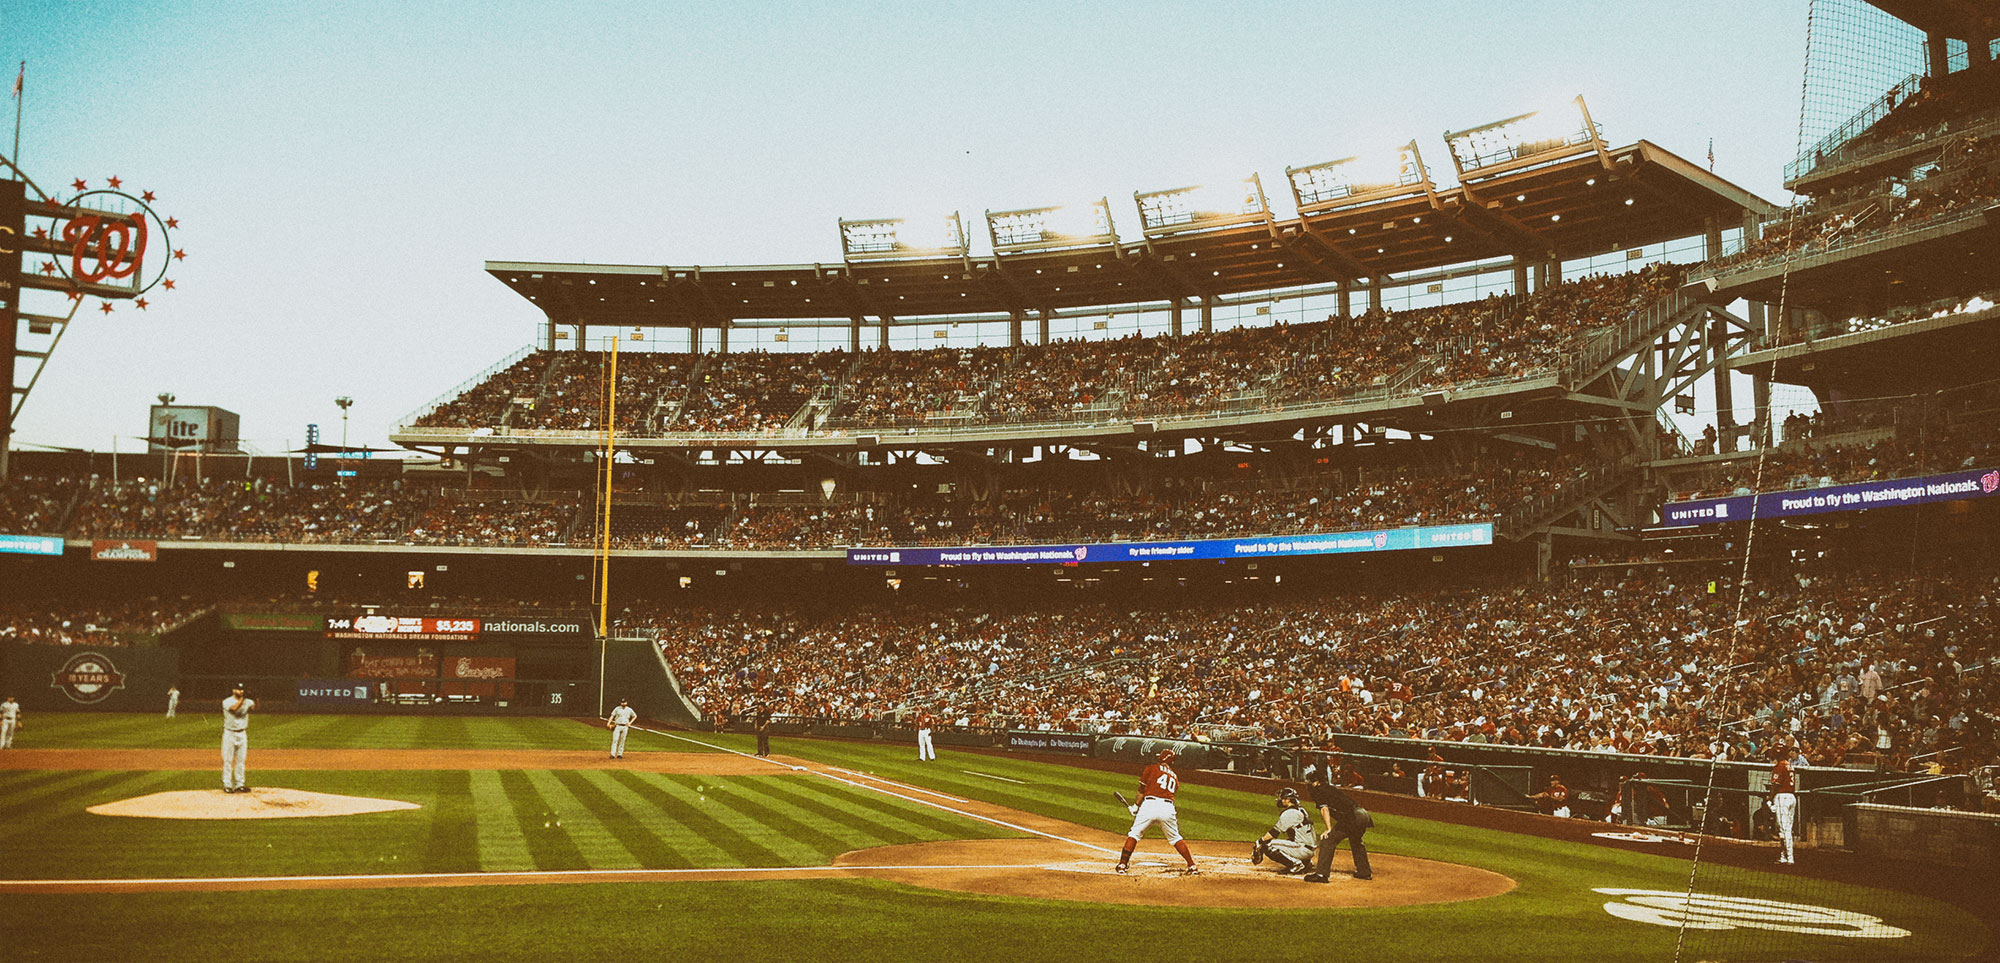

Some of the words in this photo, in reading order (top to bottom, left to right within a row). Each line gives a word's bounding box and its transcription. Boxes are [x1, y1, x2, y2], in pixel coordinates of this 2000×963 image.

[1782, 499, 1812, 511] Proud
[1813, 496, 1826, 507] to
[1826, 494, 1842, 507] fly
[1842, 492, 1860, 505] the
[1861, 486, 1926, 502] Washington
[1926, 479, 1980, 497] Nationals.
[1671, 508, 1715, 520] UNITED
[1431, 532, 1471, 542] UNITED
[1129, 548, 1139, 557] fly
[1151, 547, 1177, 555] friendly
[1234, 543, 1258, 553] Proud
[1258, 543, 1267, 552] to
[1267, 542, 1279, 553] fly
[1279, 542, 1292, 552] the
[1292, 540, 1338, 551] Washington
[940, 552, 962, 561] Proud
[963, 552, 971, 560] to
[972, 552, 982, 562] fly
[982, 552, 996, 560] the
[996, 551, 1039, 561] Washington
[436, 620, 474, 632] $5,235
[484, 620, 580, 633] nationals.com
[78, 674, 110, 683] YEARS
[299, 689, 351, 697] UNITED
[550, 693, 562, 704] 335
[1156, 773, 1176, 794] 40
